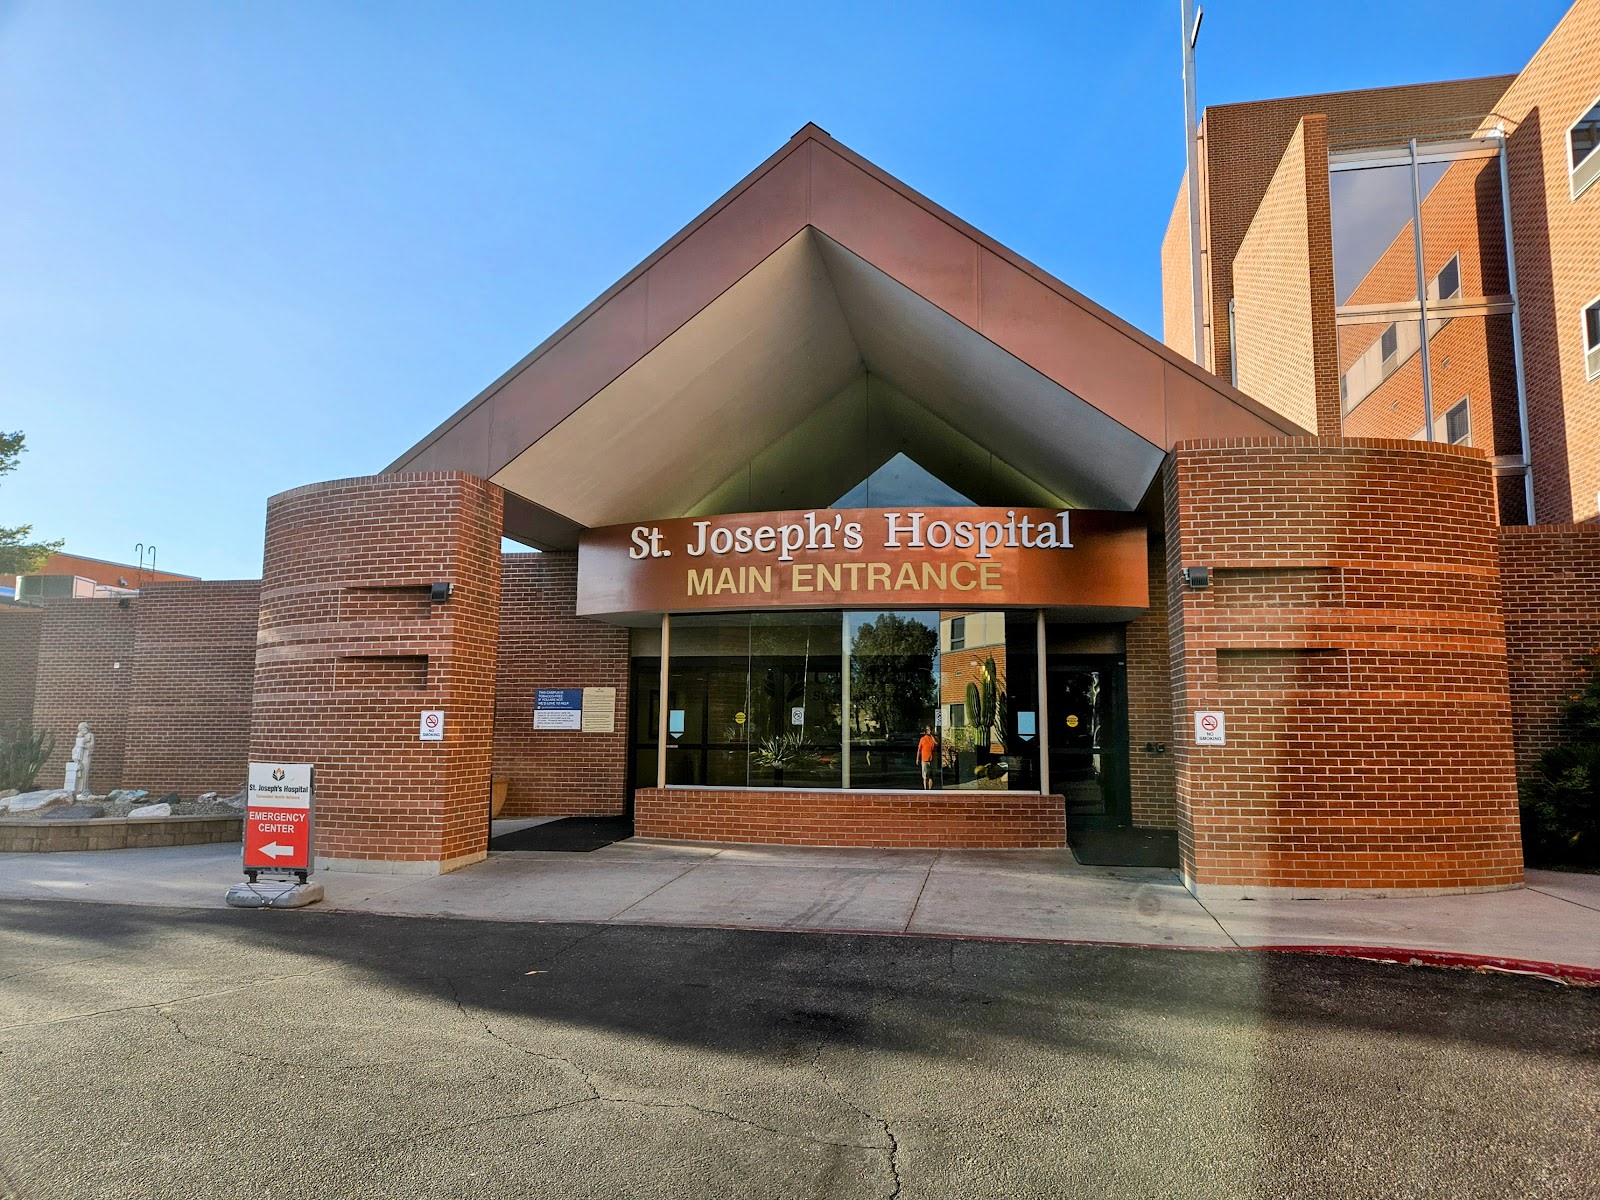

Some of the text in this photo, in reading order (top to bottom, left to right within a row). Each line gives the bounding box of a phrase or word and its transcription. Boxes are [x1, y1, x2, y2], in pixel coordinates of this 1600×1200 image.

[629, 510, 1074, 562] St. Joseph's Hospital
[686, 561, 1003, 596] MAIN ENTRANCE
[258, 784, 282, 793] Joseph's
[284, 785, 308, 794] Hospital
[249, 811, 306, 822] EMERGENCY
[258, 823, 294, 833] CENTER
